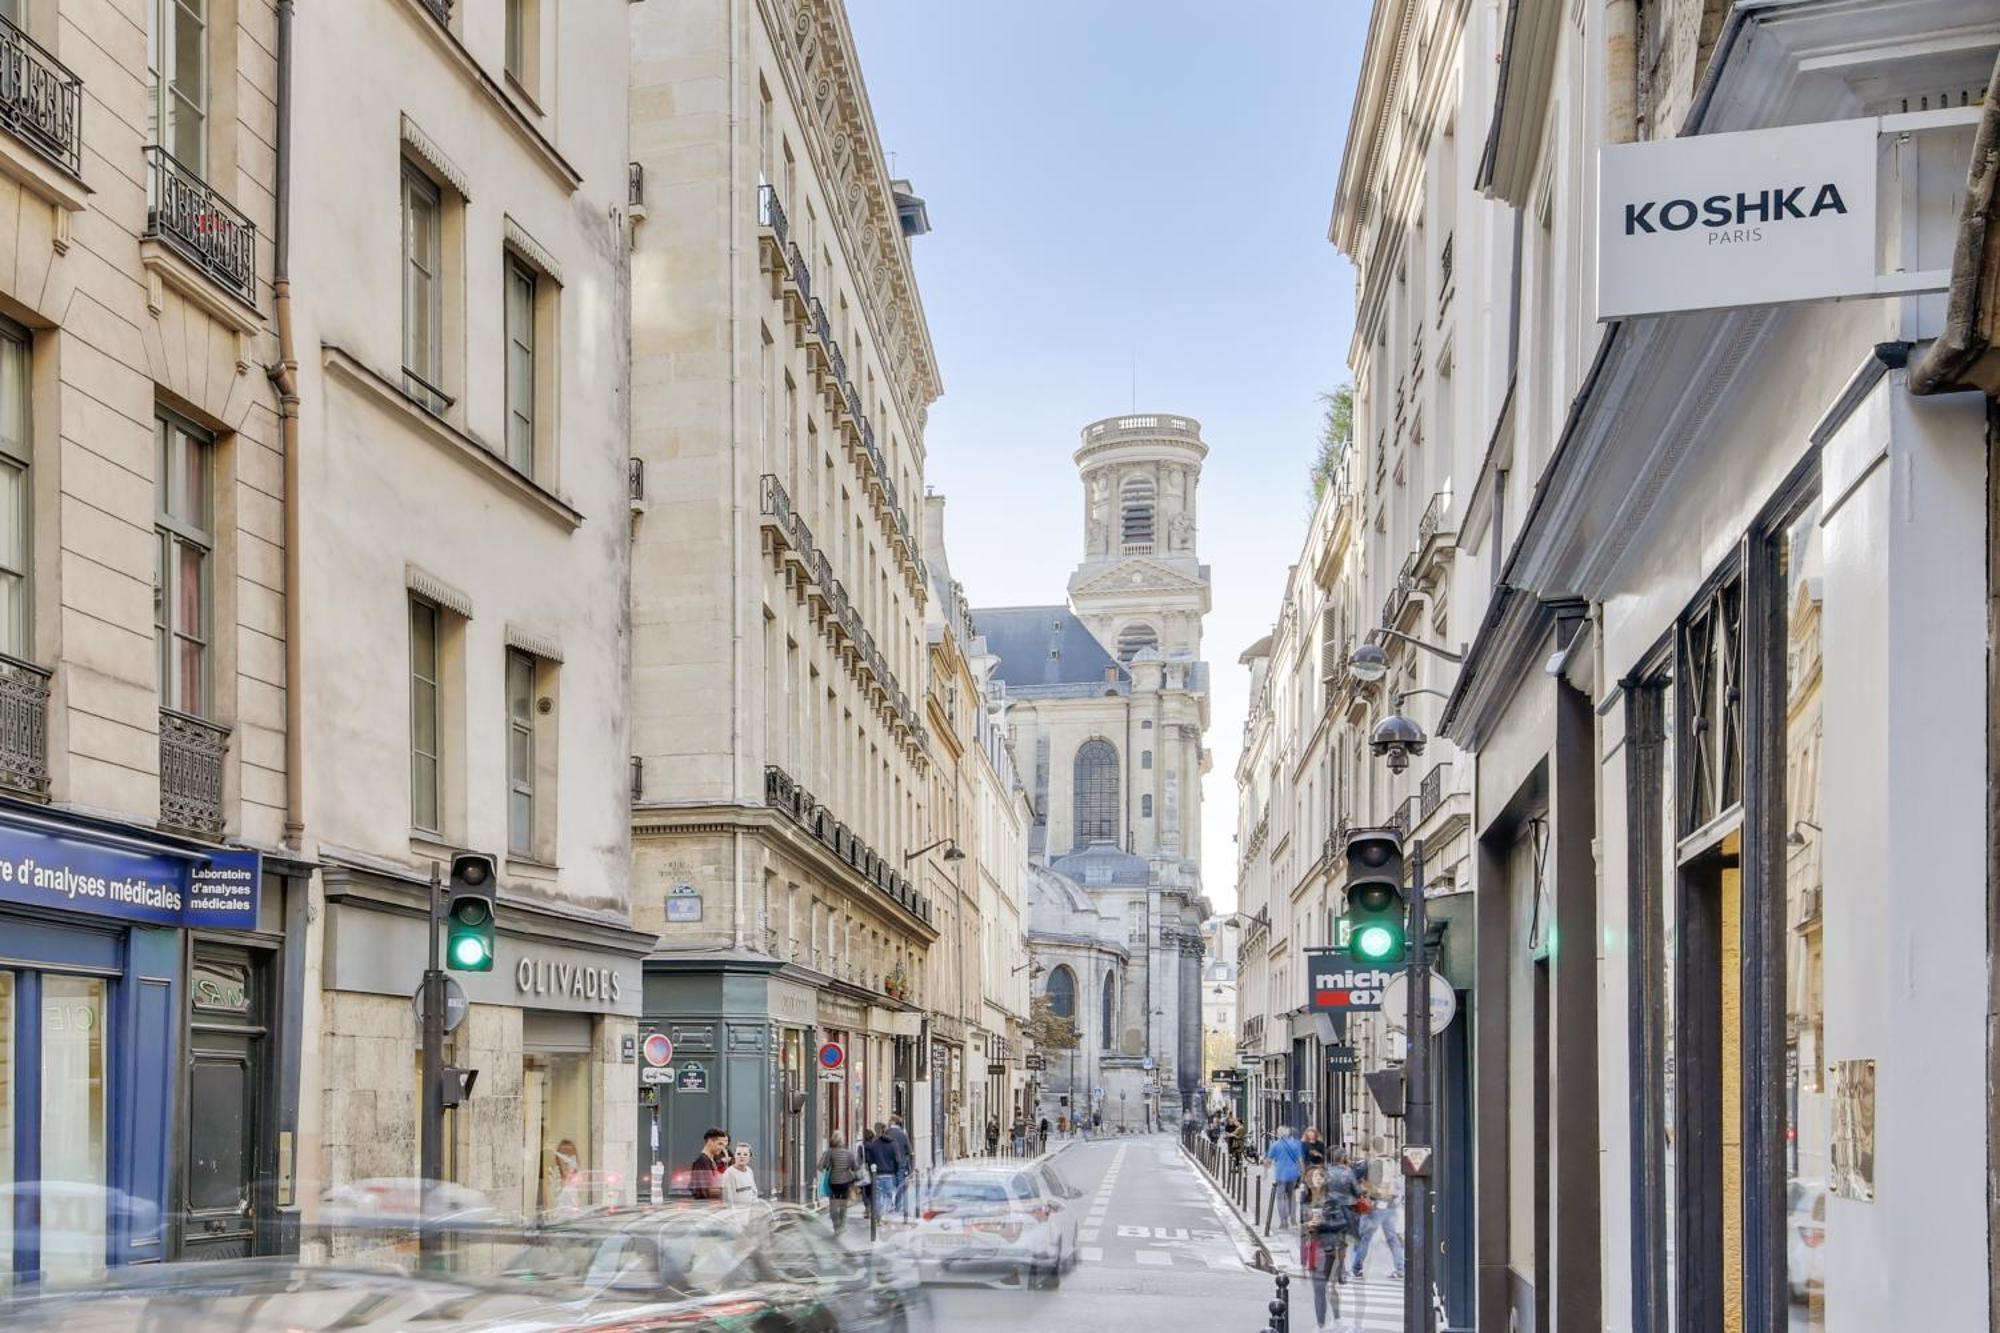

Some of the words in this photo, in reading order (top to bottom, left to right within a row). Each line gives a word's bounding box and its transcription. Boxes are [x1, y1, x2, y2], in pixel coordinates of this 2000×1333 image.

[1625, 183, 1848, 235] KOSHKA
[1708, 227, 1762, 246] PARIS
[191, 867, 252, 880] Laboratoire
[17, 858, 106, 899] d'analyses
[110, 877, 182, 910] médicales
[191, 882, 252, 896] d'analyses
[190, 897, 250, 910] médicales
[518, 956, 621, 1002] OLIVADES
[1316, 969, 1399, 989] mich
[1349, 989, 1382, 1005] ax
